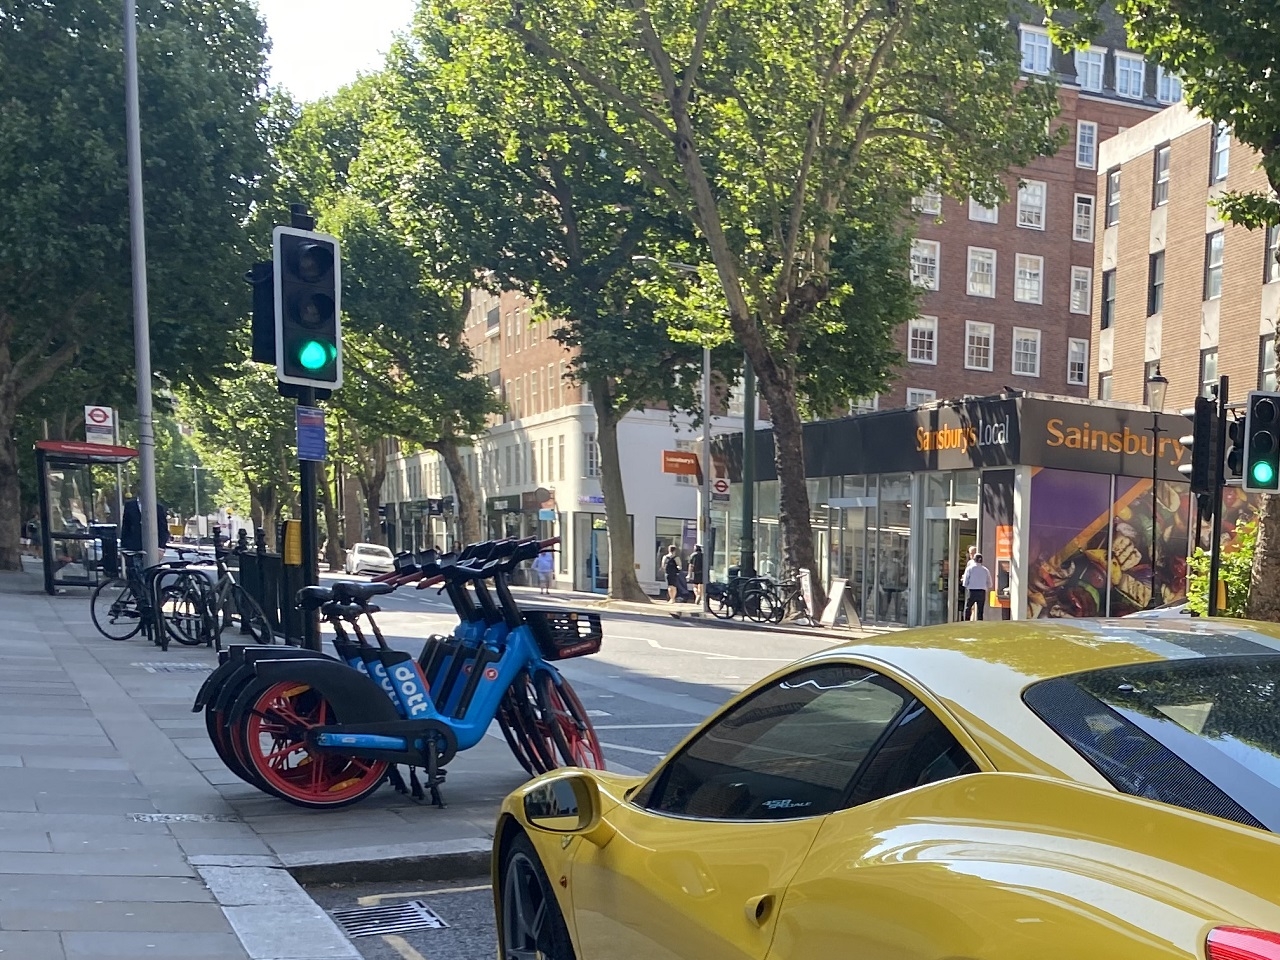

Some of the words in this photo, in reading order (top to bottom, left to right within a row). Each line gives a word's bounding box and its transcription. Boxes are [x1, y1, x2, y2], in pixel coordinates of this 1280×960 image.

[916, 423, 976, 454] Sainsbury's
[979, 415, 1009, 447] Local
[395, 666, 428, 716] dott
